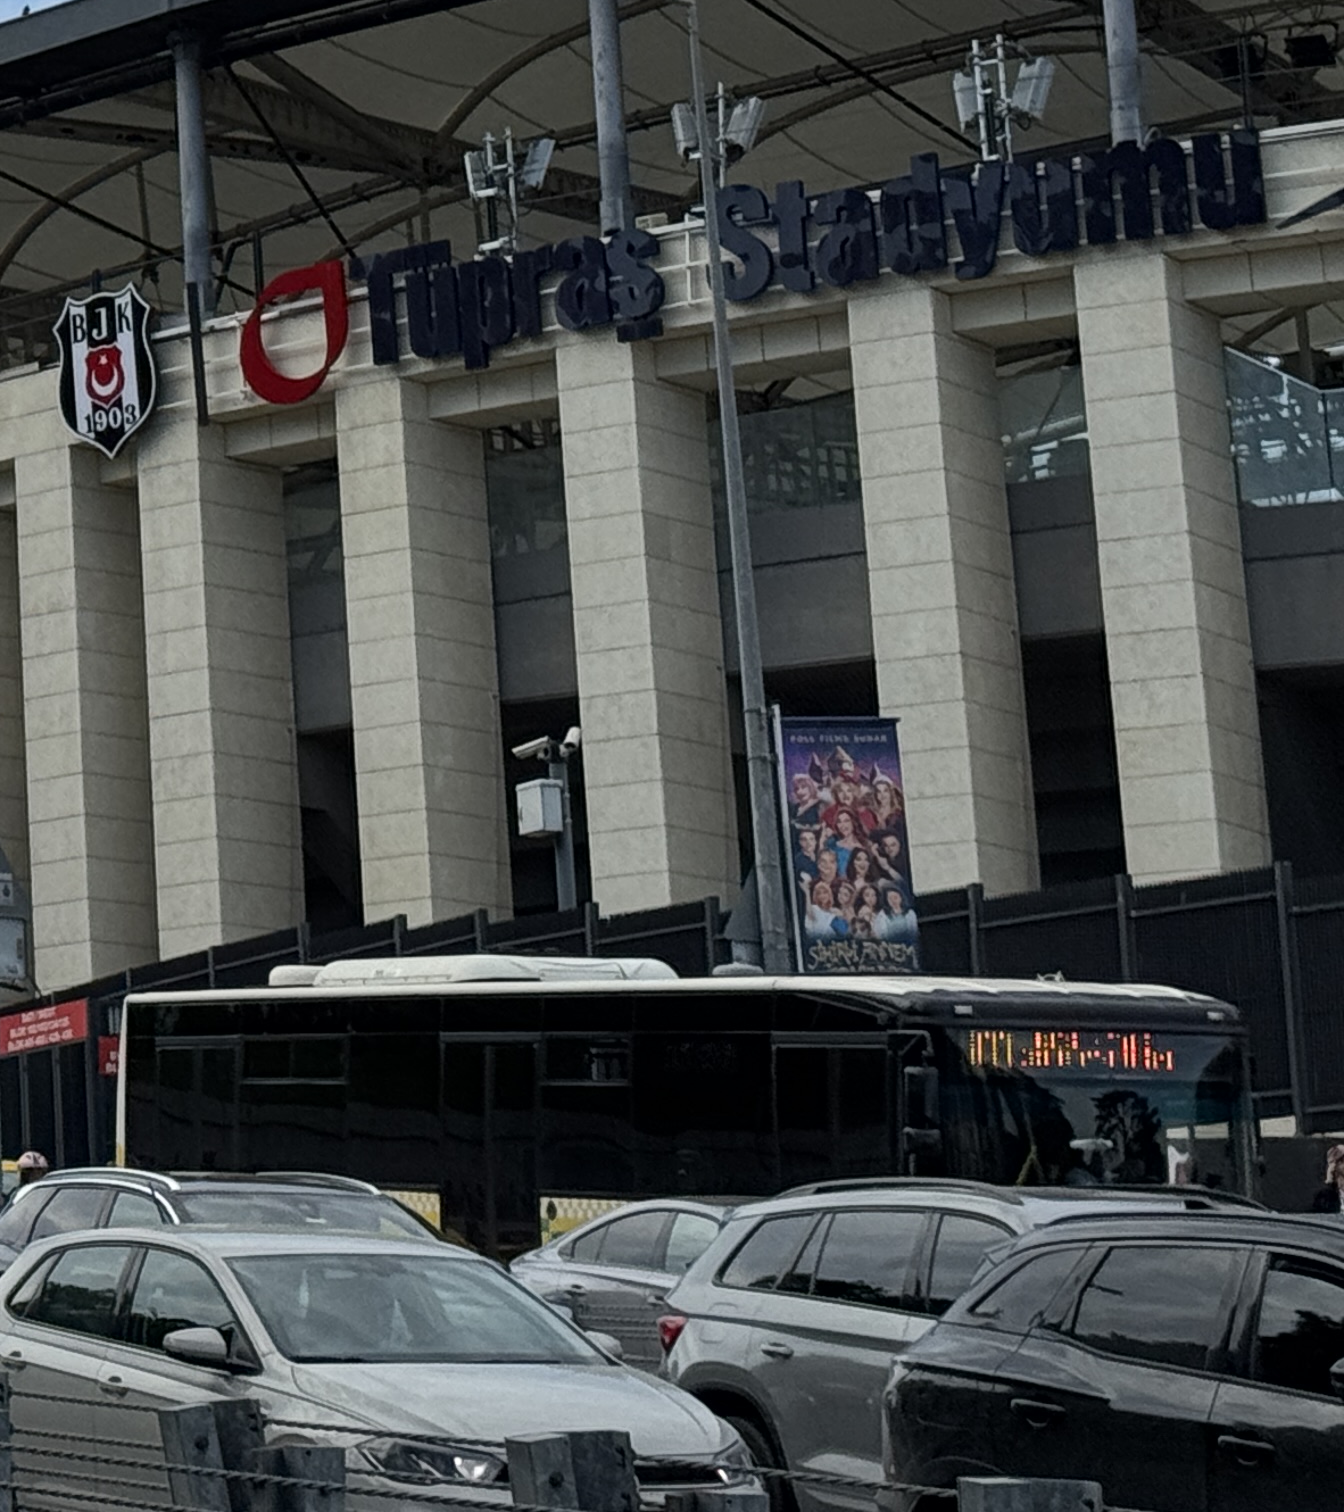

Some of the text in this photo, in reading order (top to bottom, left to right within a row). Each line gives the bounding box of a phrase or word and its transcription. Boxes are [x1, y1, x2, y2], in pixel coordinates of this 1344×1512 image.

[717, 133, 1266, 302] Stadyumu
[71, 301, 132, 344] BJK
[84, 403, 138, 435] 1903
